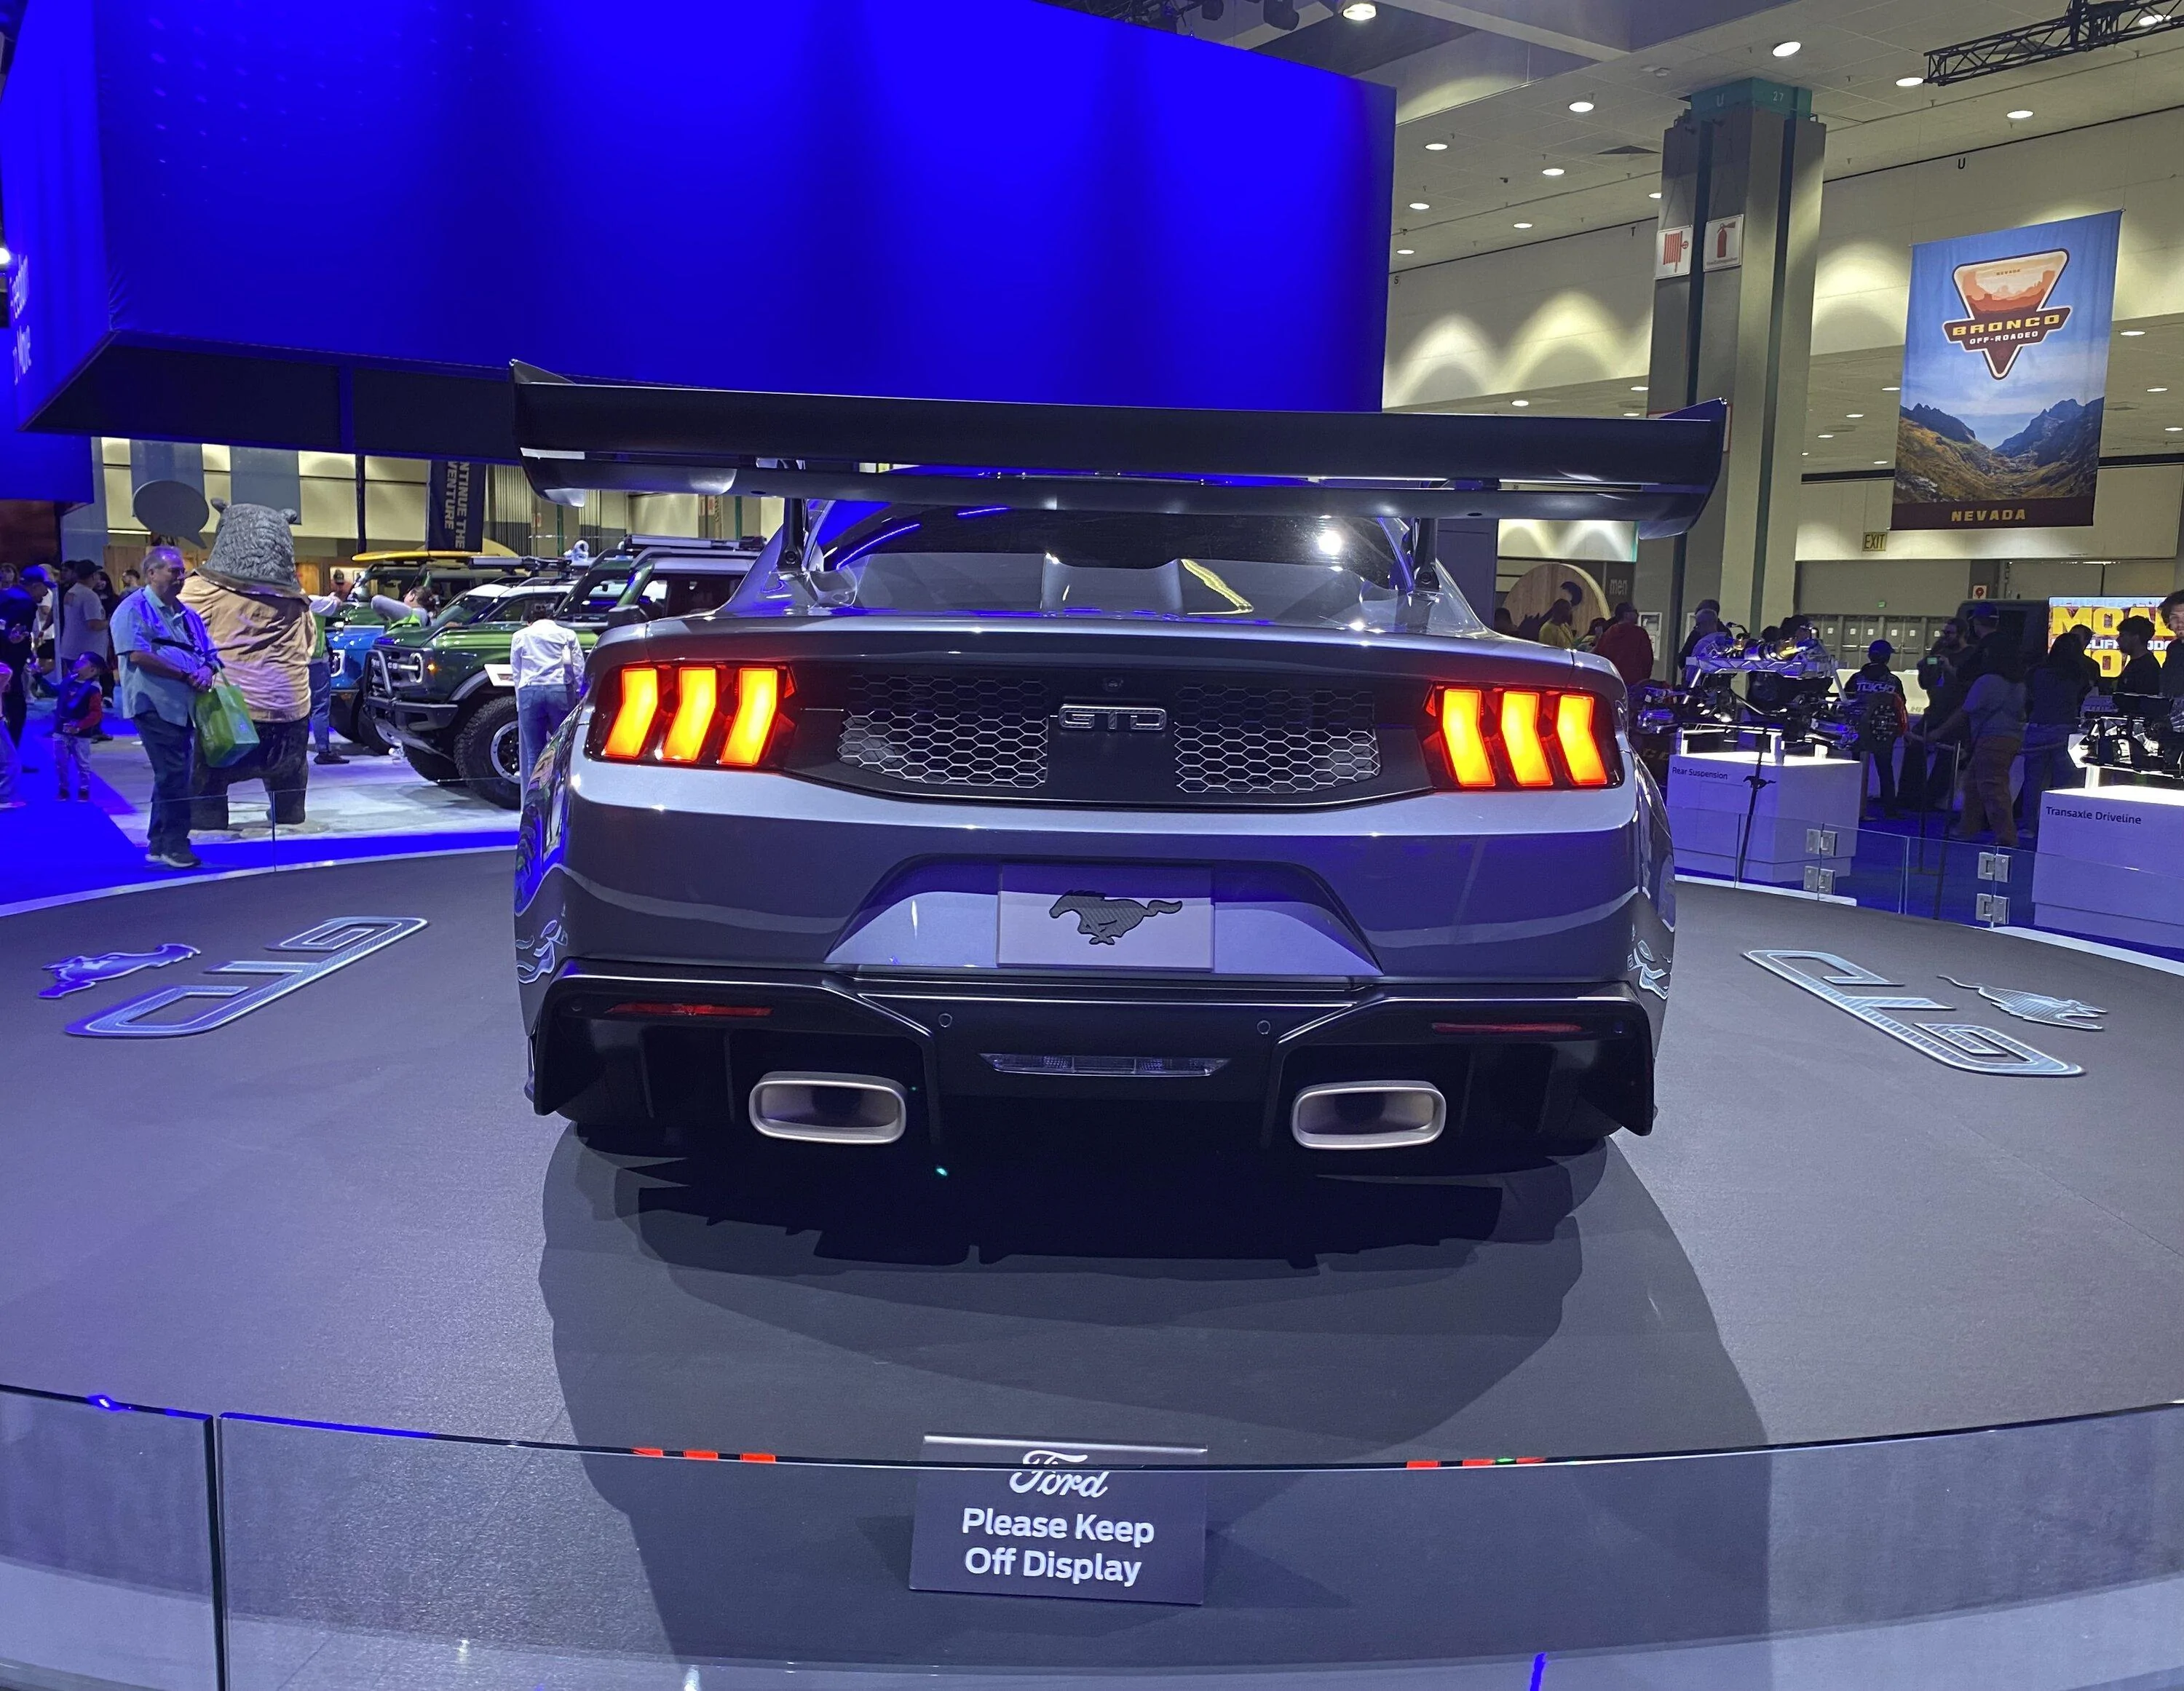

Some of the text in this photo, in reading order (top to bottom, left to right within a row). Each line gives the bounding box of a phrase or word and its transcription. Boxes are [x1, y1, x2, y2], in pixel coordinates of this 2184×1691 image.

[1772, 90, 1784, 102] 27
[1958, 157, 1966, 170] U
[1952, 314, 2061, 336] BRONCO
[1969, 330, 2038, 345] OFF-ROADEO
[1951, 509, 2026, 522] NEVADA
[455, 519, 467, 550] THE
[1864, 533, 1885, 549] EXIT
[1609, 579, 1628, 595] men
[1059, 704, 1167, 730] GTD
[1672, 767, 1728, 780] Rear Suspension
[2046, 807, 2142, 825] Transaxle Driveline
[64, 915, 430, 1037] GTD
[1741, 949, 2086, 1077] GTD
[1009, 1449, 1109, 1498] Ford
[962, 1508, 1155, 1548] Please Keep
[965, 1547, 1142, 1587] Off Display
